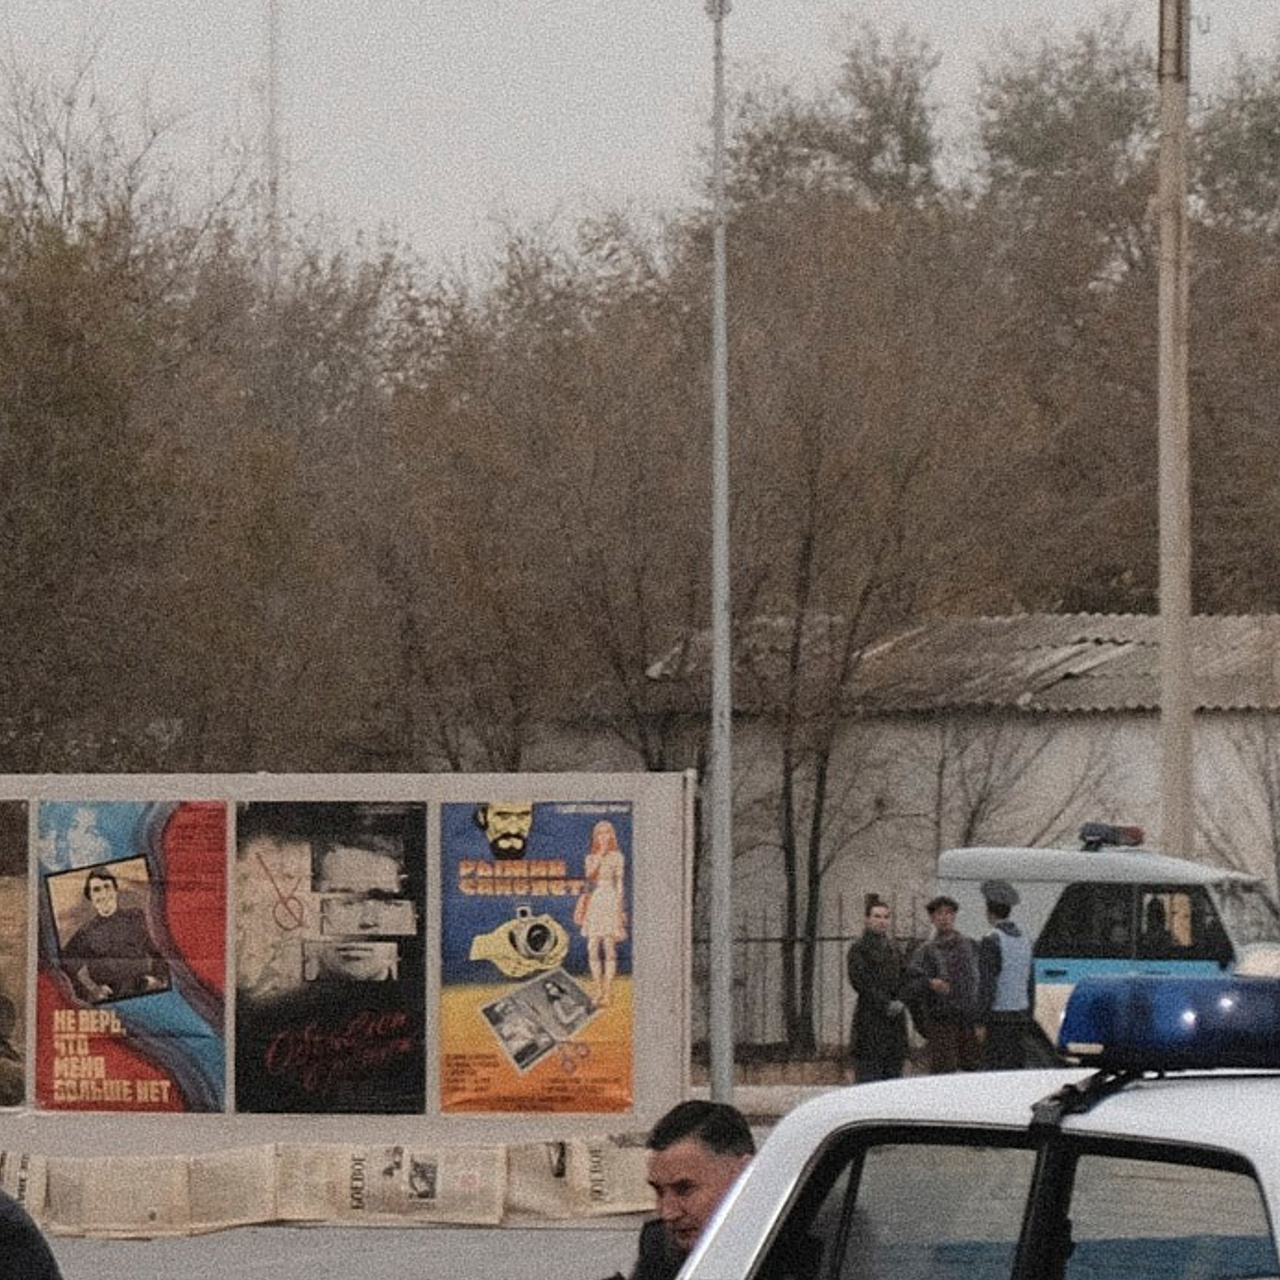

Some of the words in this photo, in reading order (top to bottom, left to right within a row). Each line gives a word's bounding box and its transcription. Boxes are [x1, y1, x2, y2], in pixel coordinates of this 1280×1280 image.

[54, 1009, 75, 1033] НЕ
[54, 1034, 89, 1056] ЧТО
[54, 1056, 106, 1079] МЕНЯ
[53, 1079, 133, 1103] БОЛЬШЕ
[136, 1079, 171, 1103] НЕТ
